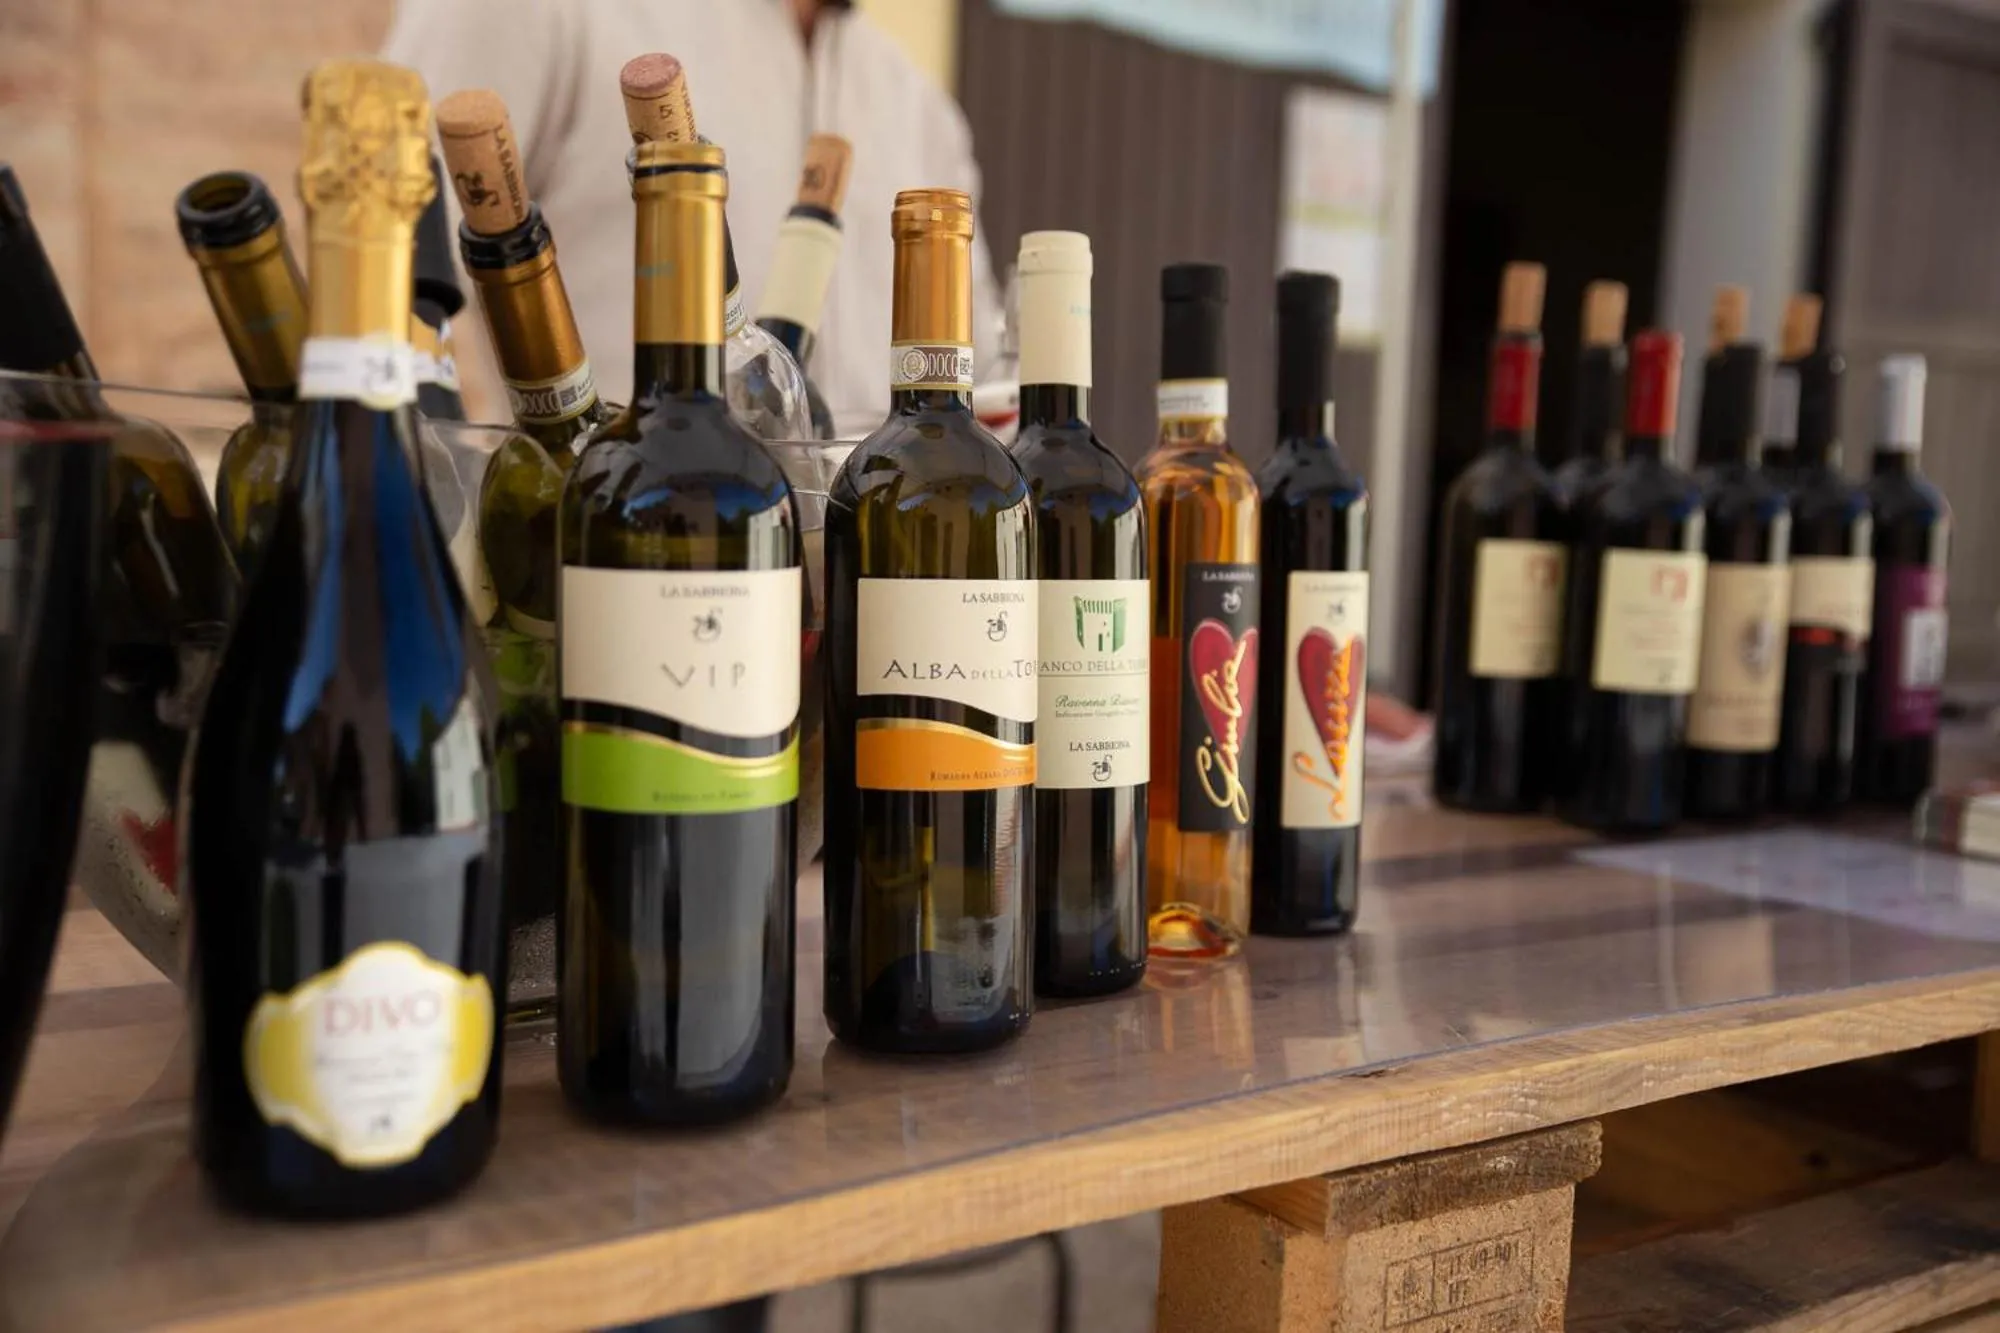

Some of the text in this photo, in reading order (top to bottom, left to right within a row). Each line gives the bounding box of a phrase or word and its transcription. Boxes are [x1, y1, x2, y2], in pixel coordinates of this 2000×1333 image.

[660, 584, 680, 598] LA
[962, 592, 978, 603] LA
[882, 659, 967, 680] ALBA
[1040, 660, 1083, 672] ANCO
[660, 661, 747, 689] VIP
[1069, 742, 1084, 752] LA
[323, 988, 443, 1039] DIVO
